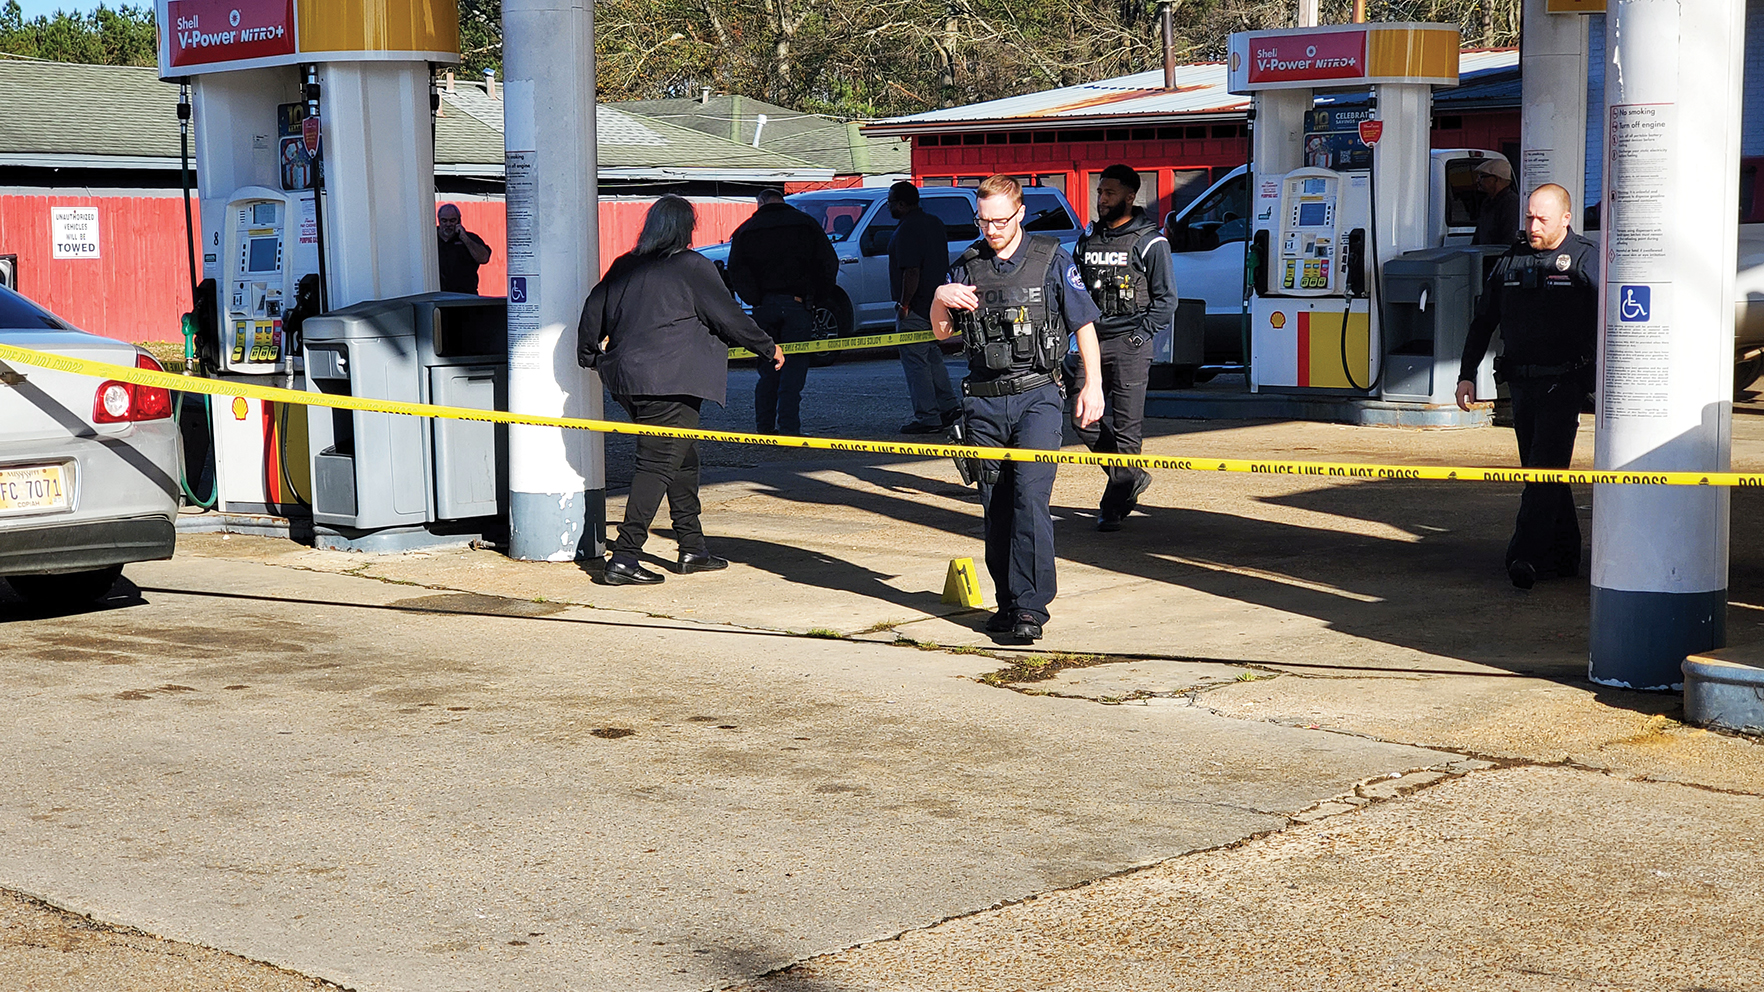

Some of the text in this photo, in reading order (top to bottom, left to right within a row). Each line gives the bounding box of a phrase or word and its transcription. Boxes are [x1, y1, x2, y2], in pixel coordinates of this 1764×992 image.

[176, 17, 198, 31] Shell
[177, 28, 237, 50] V-Power
[1256, 48, 1278, 59] Shell
[1257, 58, 1311, 73] V-Power
[287, 105, 304, 124] 10
[1313, 111, 1329, 125] 10
[1335, 111, 1369, 120] CELEBRAT
[1628, 108, 1656, 117] smoking
[1642, 121, 1666, 130] engine
[55, 213, 95, 221] UNAUTHORIZED
[63, 223, 88, 231] VEHICLES
[213, 231, 219, 246] 8
[57, 243, 96, 252] TOWED
[1084, 251, 1129, 266] POLICE
[25, 478, 62, 500] 7071
[17, 500, 40, 508] COPIAH
